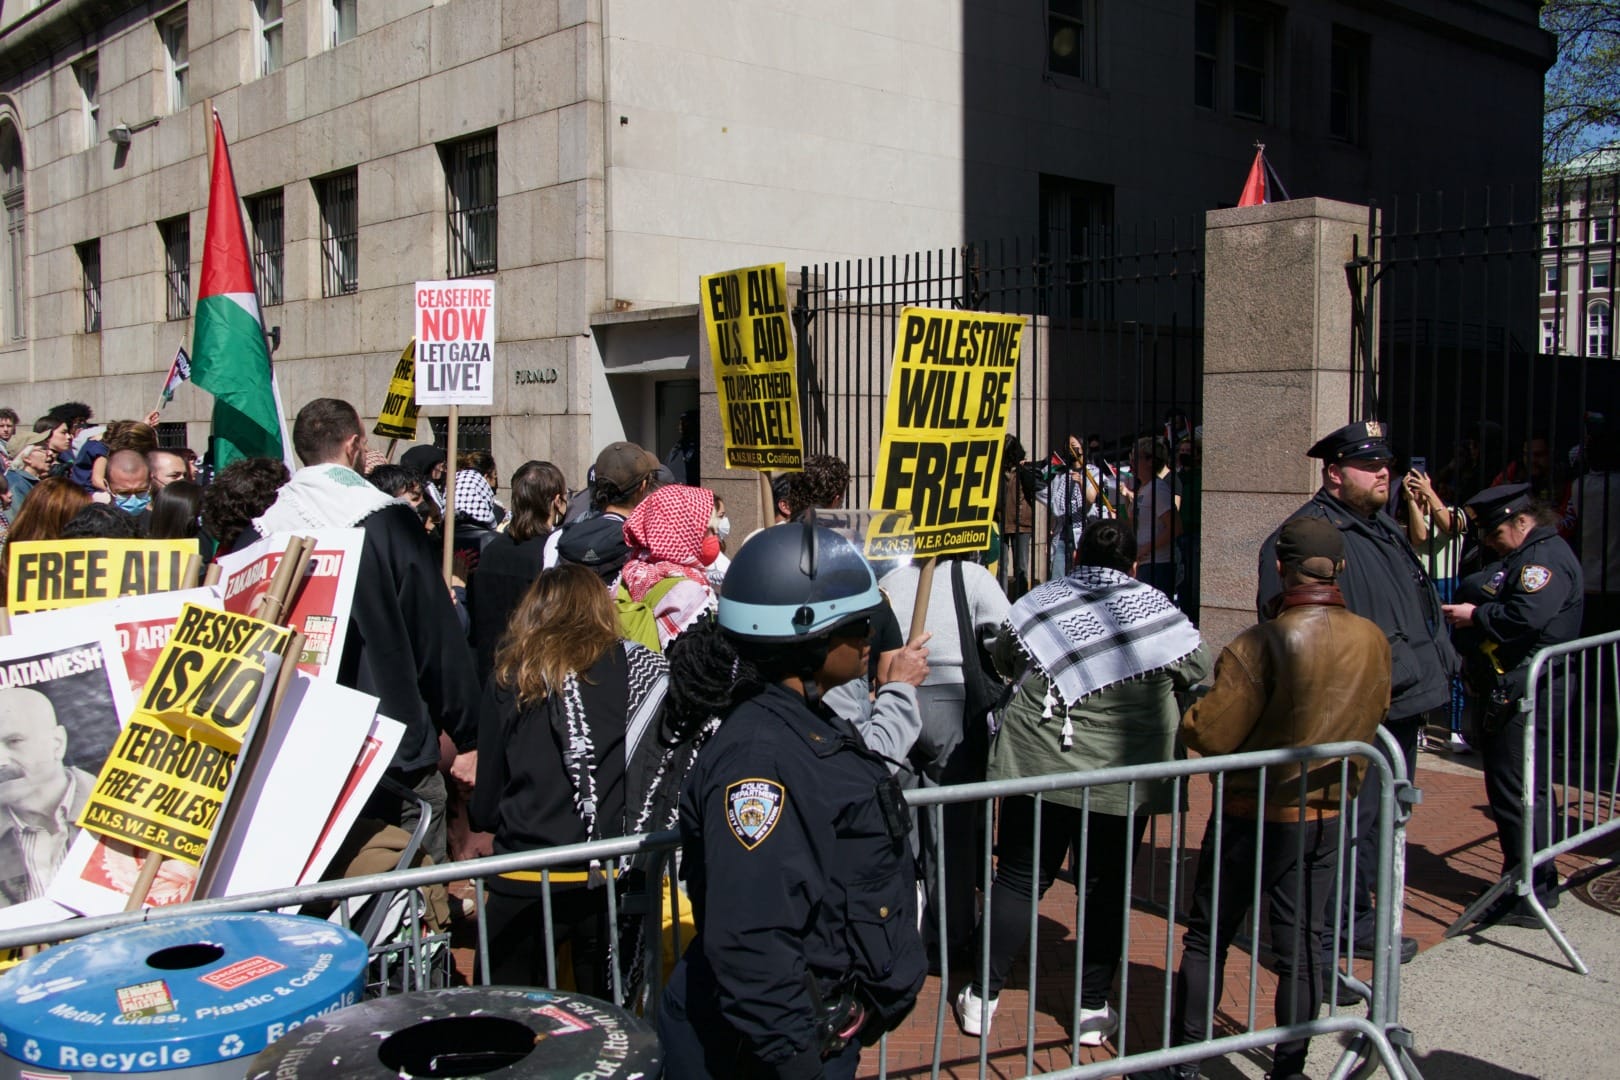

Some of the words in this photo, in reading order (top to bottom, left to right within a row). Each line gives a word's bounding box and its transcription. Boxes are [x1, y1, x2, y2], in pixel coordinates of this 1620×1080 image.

[417, 288, 491, 308] CEASEFIRE
[708, 274, 741, 321] END
[747, 267, 785, 316] ALL
[422, 308, 487, 341] NOW
[716, 321, 747, 366] U.S.
[753, 315, 788, 363] AID
[902, 315, 1022, 367] PALESTINE
[419, 343, 446, 362] LET
[449, 342, 491, 362] GAZA
[427, 363, 481, 391] LIVE!
[515, 369, 557, 384] FURNALD
[722, 375, 736, 400] TO
[736, 372, 792, 400] APARTHEID
[382, 391, 406, 416] NOT
[898, 367, 971, 429] WILL
[975, 371, 1012, 428] BE
[728, 400, 794, 445] ISRAEL!
[767, 452, 800, 465] Coalition
[880, 440, 999, 528] FREE!
[943, 530, 985, 545] Coalition
[16, 550, 108, 602] FREE
[225, 557, 268, 600] ZAKARIA
[144, 646, 204, 712] IS
[178, 656, 265, 728] NO
[97, 767, 152, 805] FREE
[730, 789, 779, 801] DEPARTMENT
[741, 782, 769, 791] POLICE
[88, 806, 169, 846] A.N.S.W.E.R.
[729, 809, 738, 826] CITY
[735, 826, 745, 836] OF
[754, 825, 769, 840] NEW
[765, 806, 779, 825] YORK
[48, 1003, 107, 1026] Metal,
[195, 993, 275, 1019] Plastic
[273, 986, 295, 996] &
[289, 953, 333, 987] Cartons
[59, 1045, 191, 1071] Recycle
